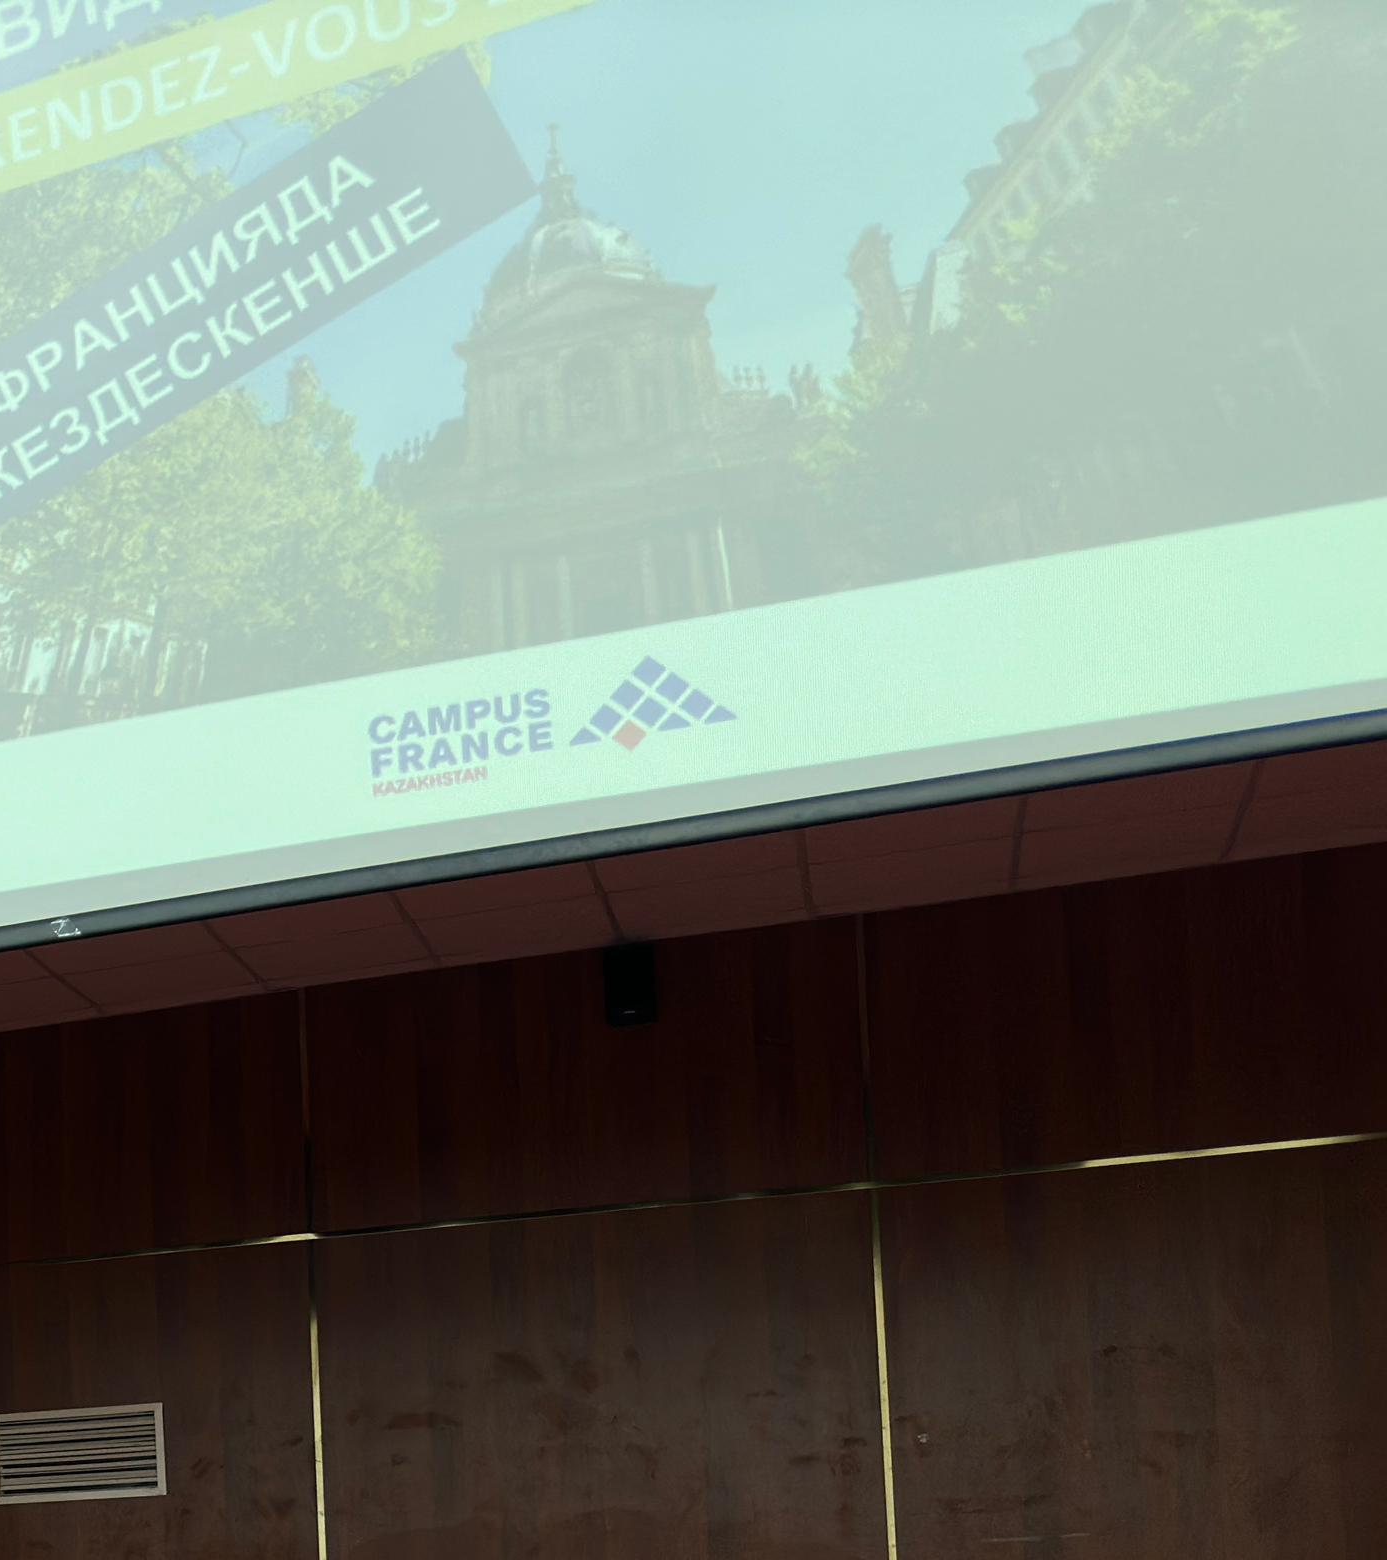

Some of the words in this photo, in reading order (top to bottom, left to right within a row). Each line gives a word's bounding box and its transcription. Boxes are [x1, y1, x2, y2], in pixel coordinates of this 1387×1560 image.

[367, 688, 551, 746] CAMPUS
[370, 720, 555, 779] FRANCE
[371, 766, 489, 798] KAZAKHSTAN
